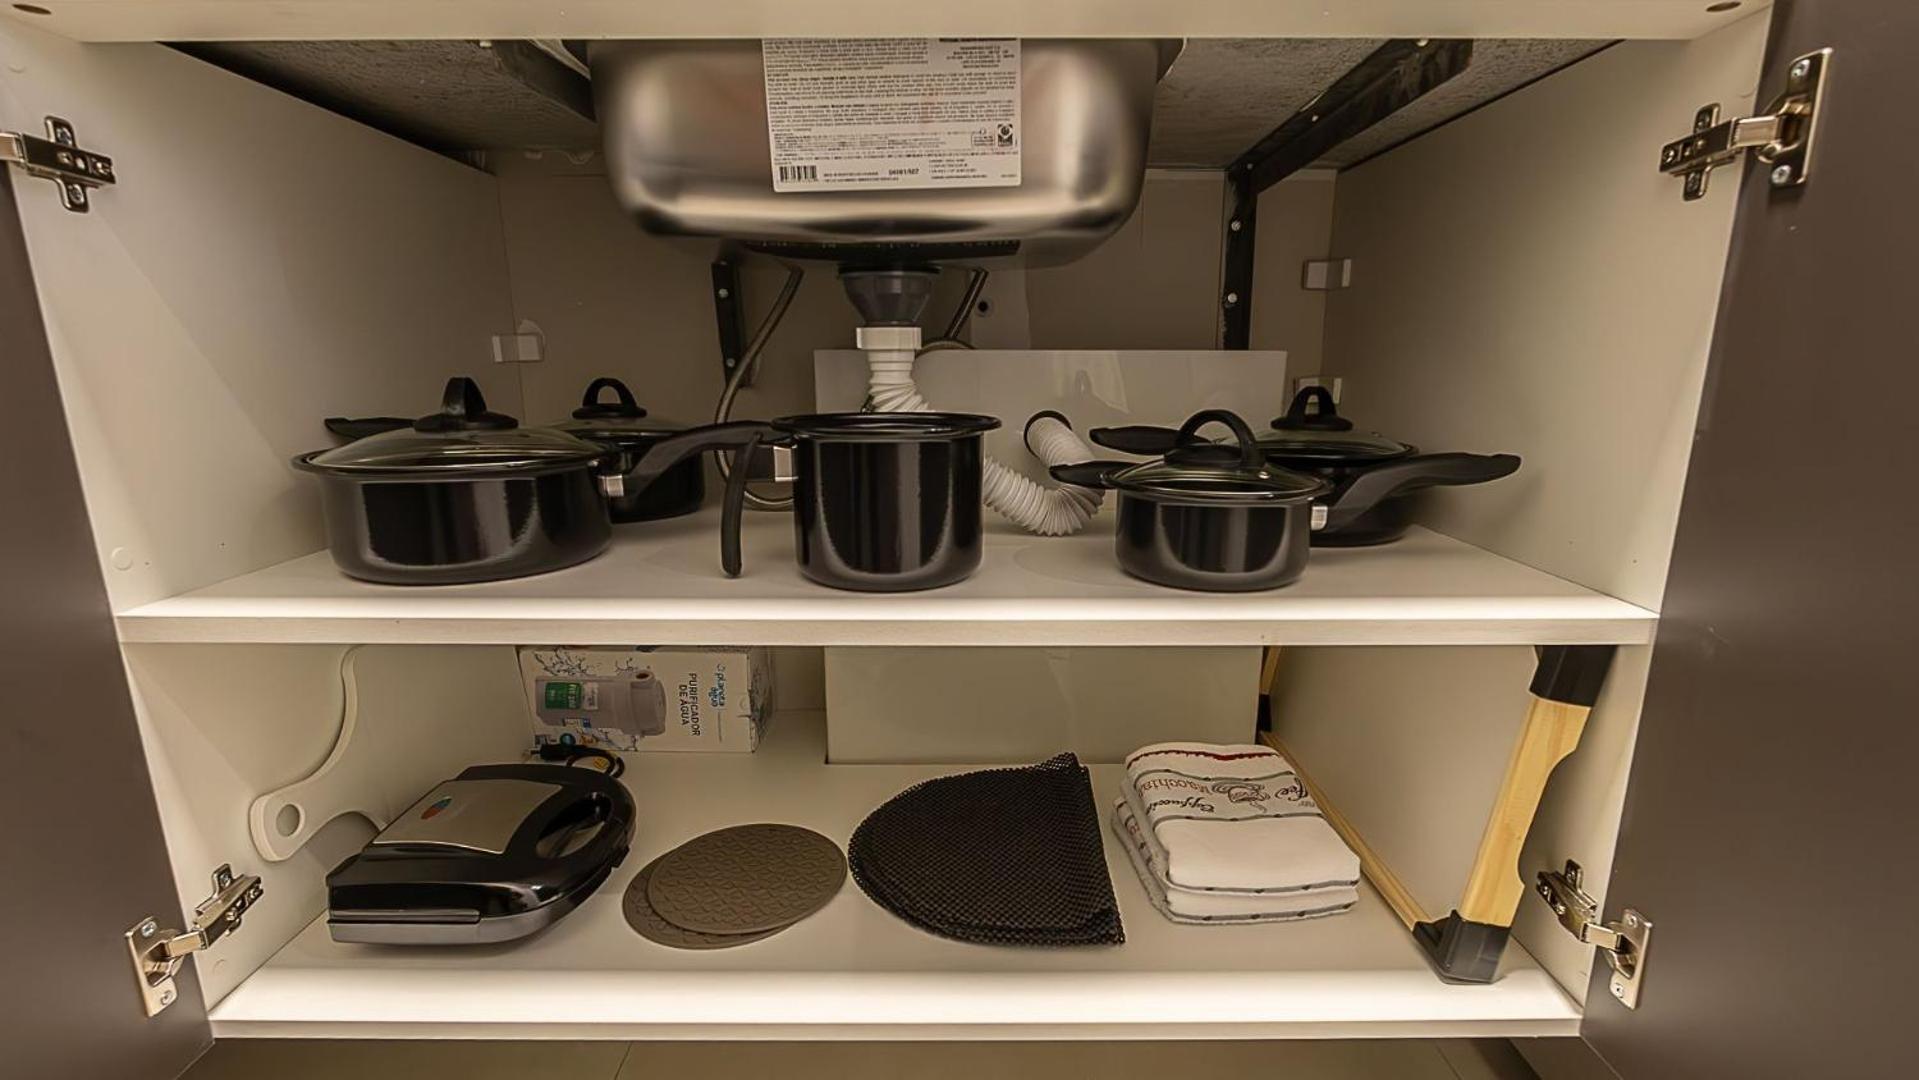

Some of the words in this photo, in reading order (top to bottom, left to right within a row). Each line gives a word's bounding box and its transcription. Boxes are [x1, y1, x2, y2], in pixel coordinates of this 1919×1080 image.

[679, 684, 688, 697] DE
[689, 672, 700, 736] PURIFICADOR
[714, 672, 726, 706] planeta
